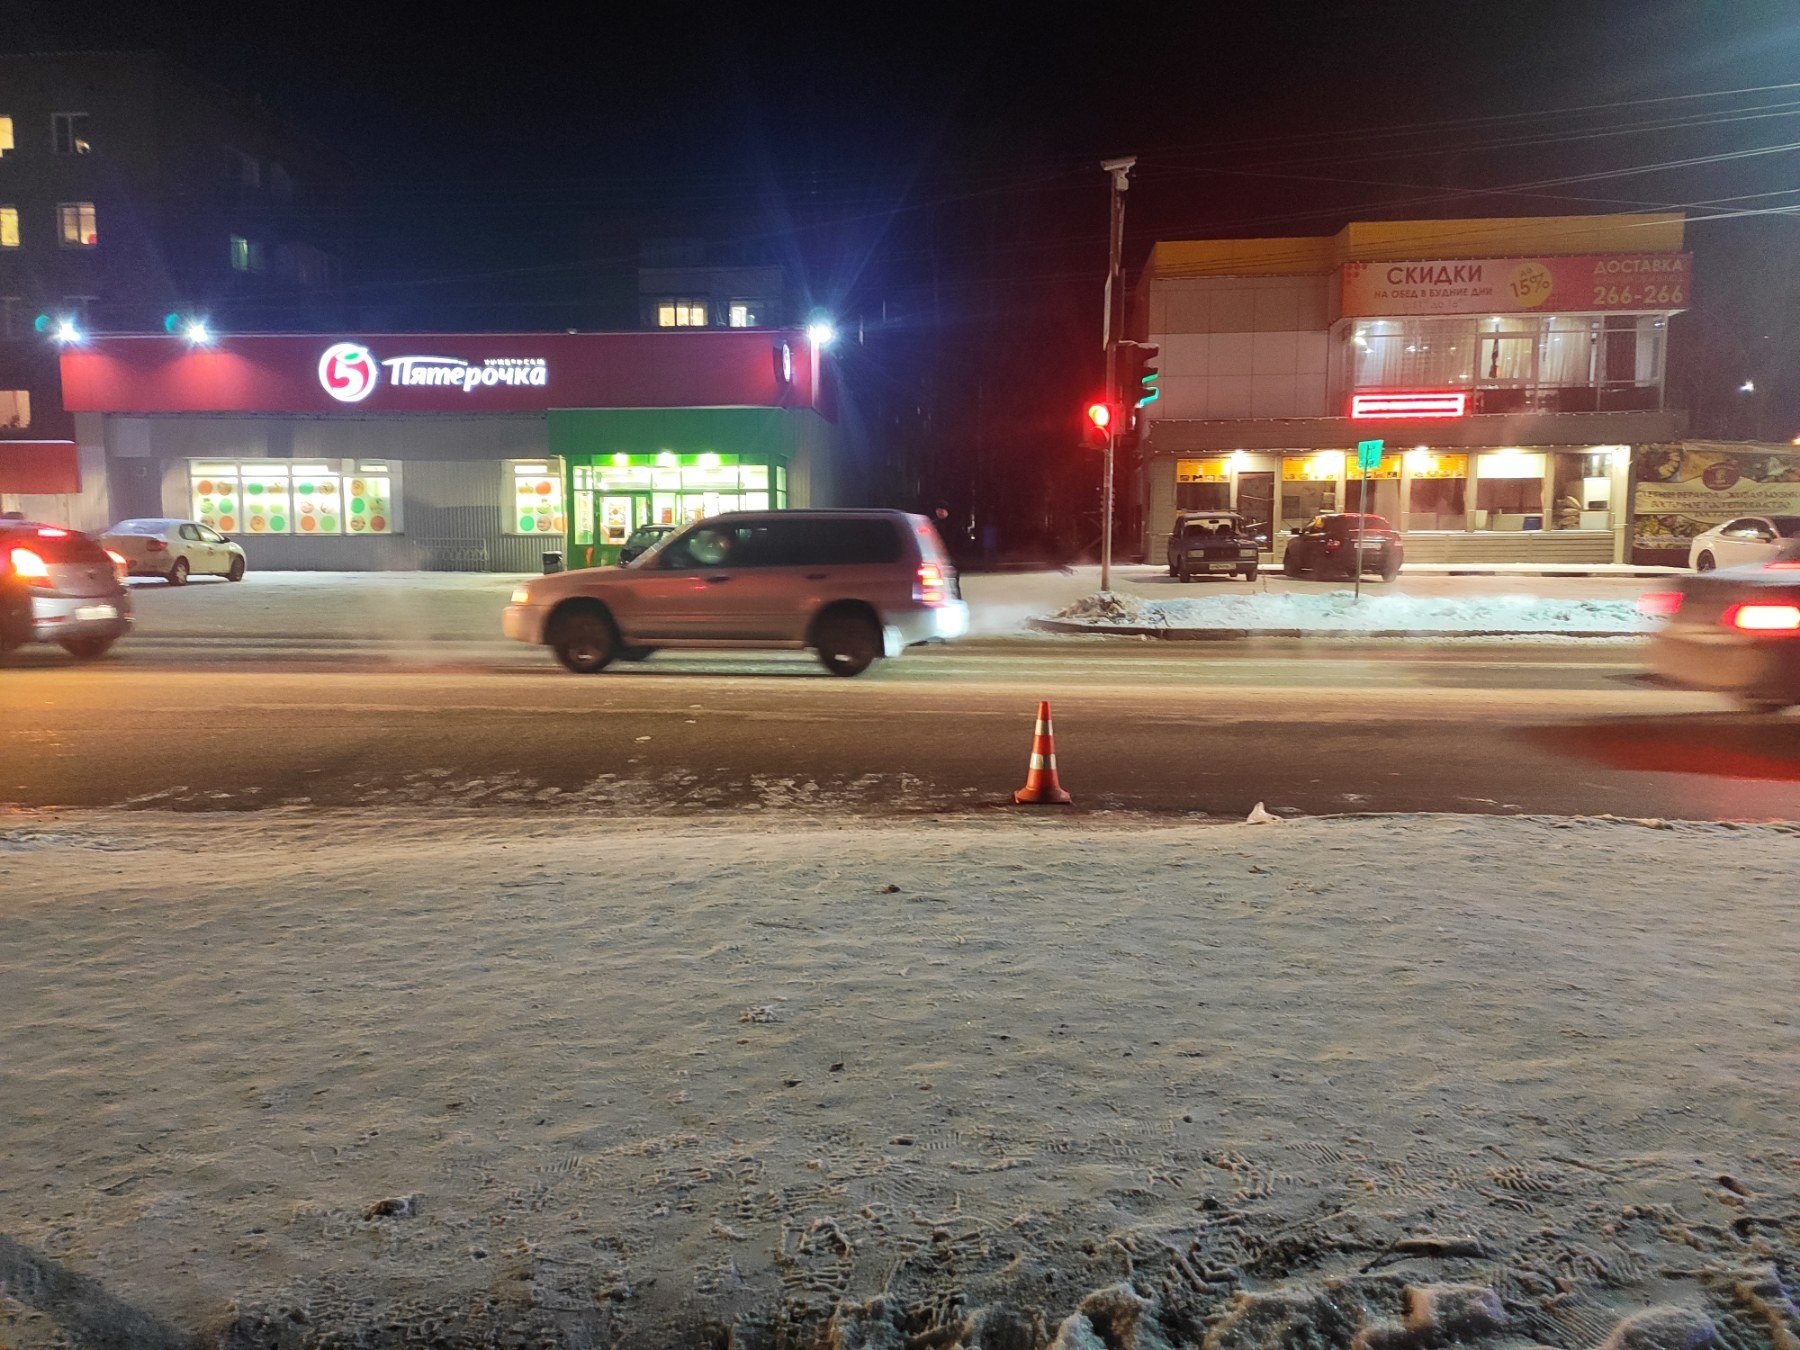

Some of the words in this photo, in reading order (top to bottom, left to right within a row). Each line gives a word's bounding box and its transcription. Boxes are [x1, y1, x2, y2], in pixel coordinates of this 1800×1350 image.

[1387, 264, 1483, 285] СКИДКИ
[1593, 259, 1684, 274] ДОСТАВКА
[1374, 290, 1388, 299] НА
[1391, 289, 1419, 299] ОБЕД
[1420, 289, 1427, 298] В
[1429, 288, 1468, 298] БУДНИЕ
[1470, 287, 1493, 297] ДНИ
[1510, 272, 1550, 297] 15%
[1592, 285, 1683, 305] 266-266
[382, 355, 547, 391] Пятерочка
